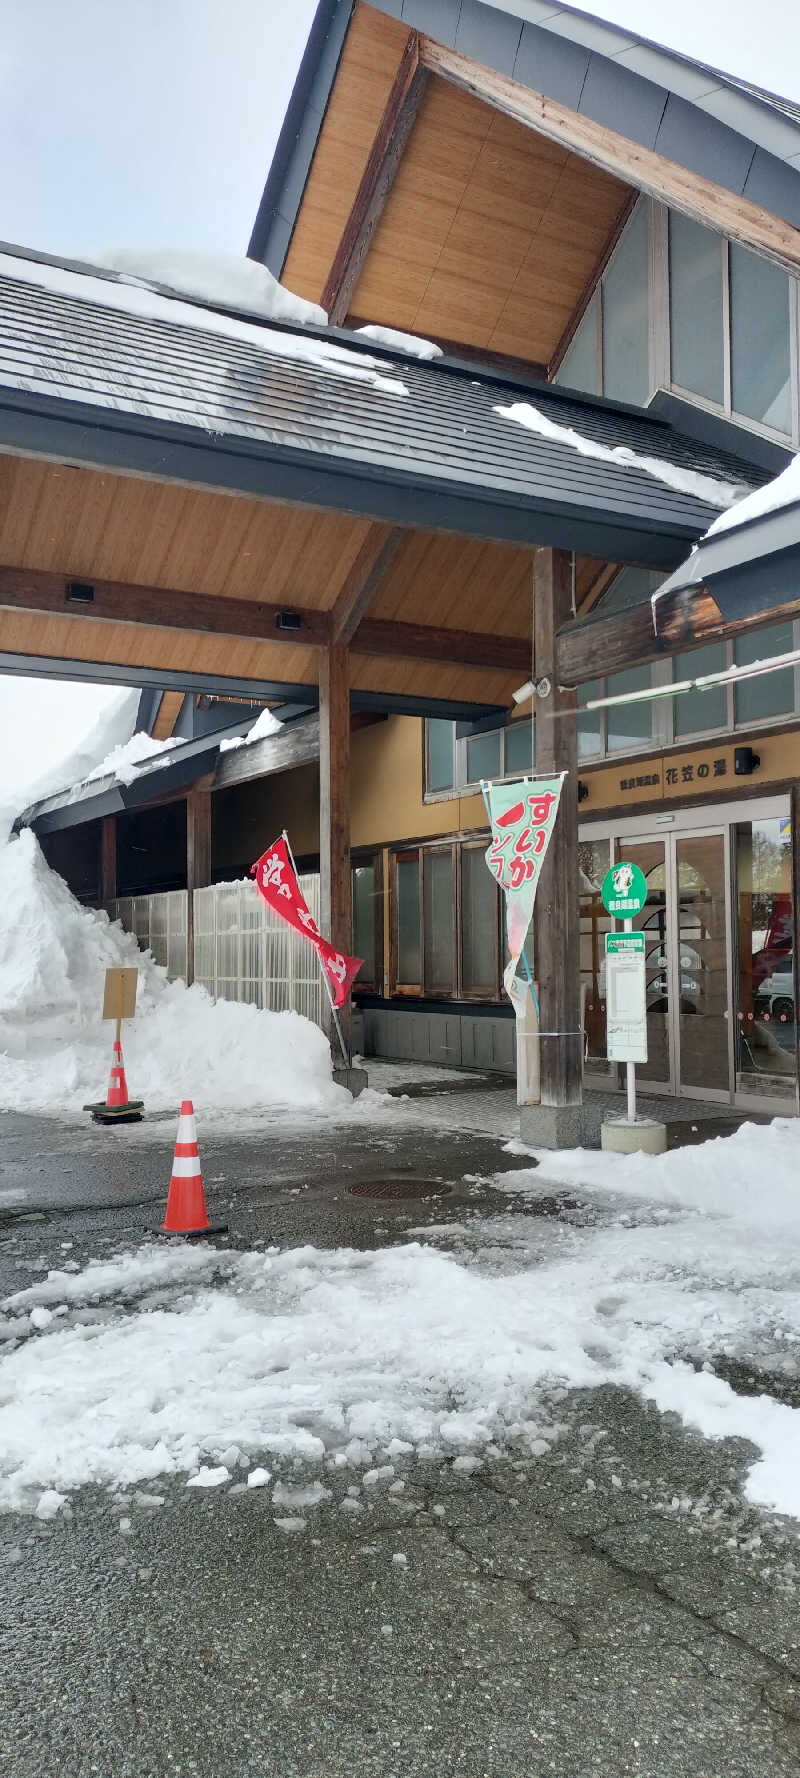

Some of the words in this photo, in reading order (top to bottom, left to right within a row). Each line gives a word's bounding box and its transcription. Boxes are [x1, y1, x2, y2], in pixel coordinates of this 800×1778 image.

[665, 759, 727, 785] 花笠の湯
[508, 791, 557, 889] すいか
